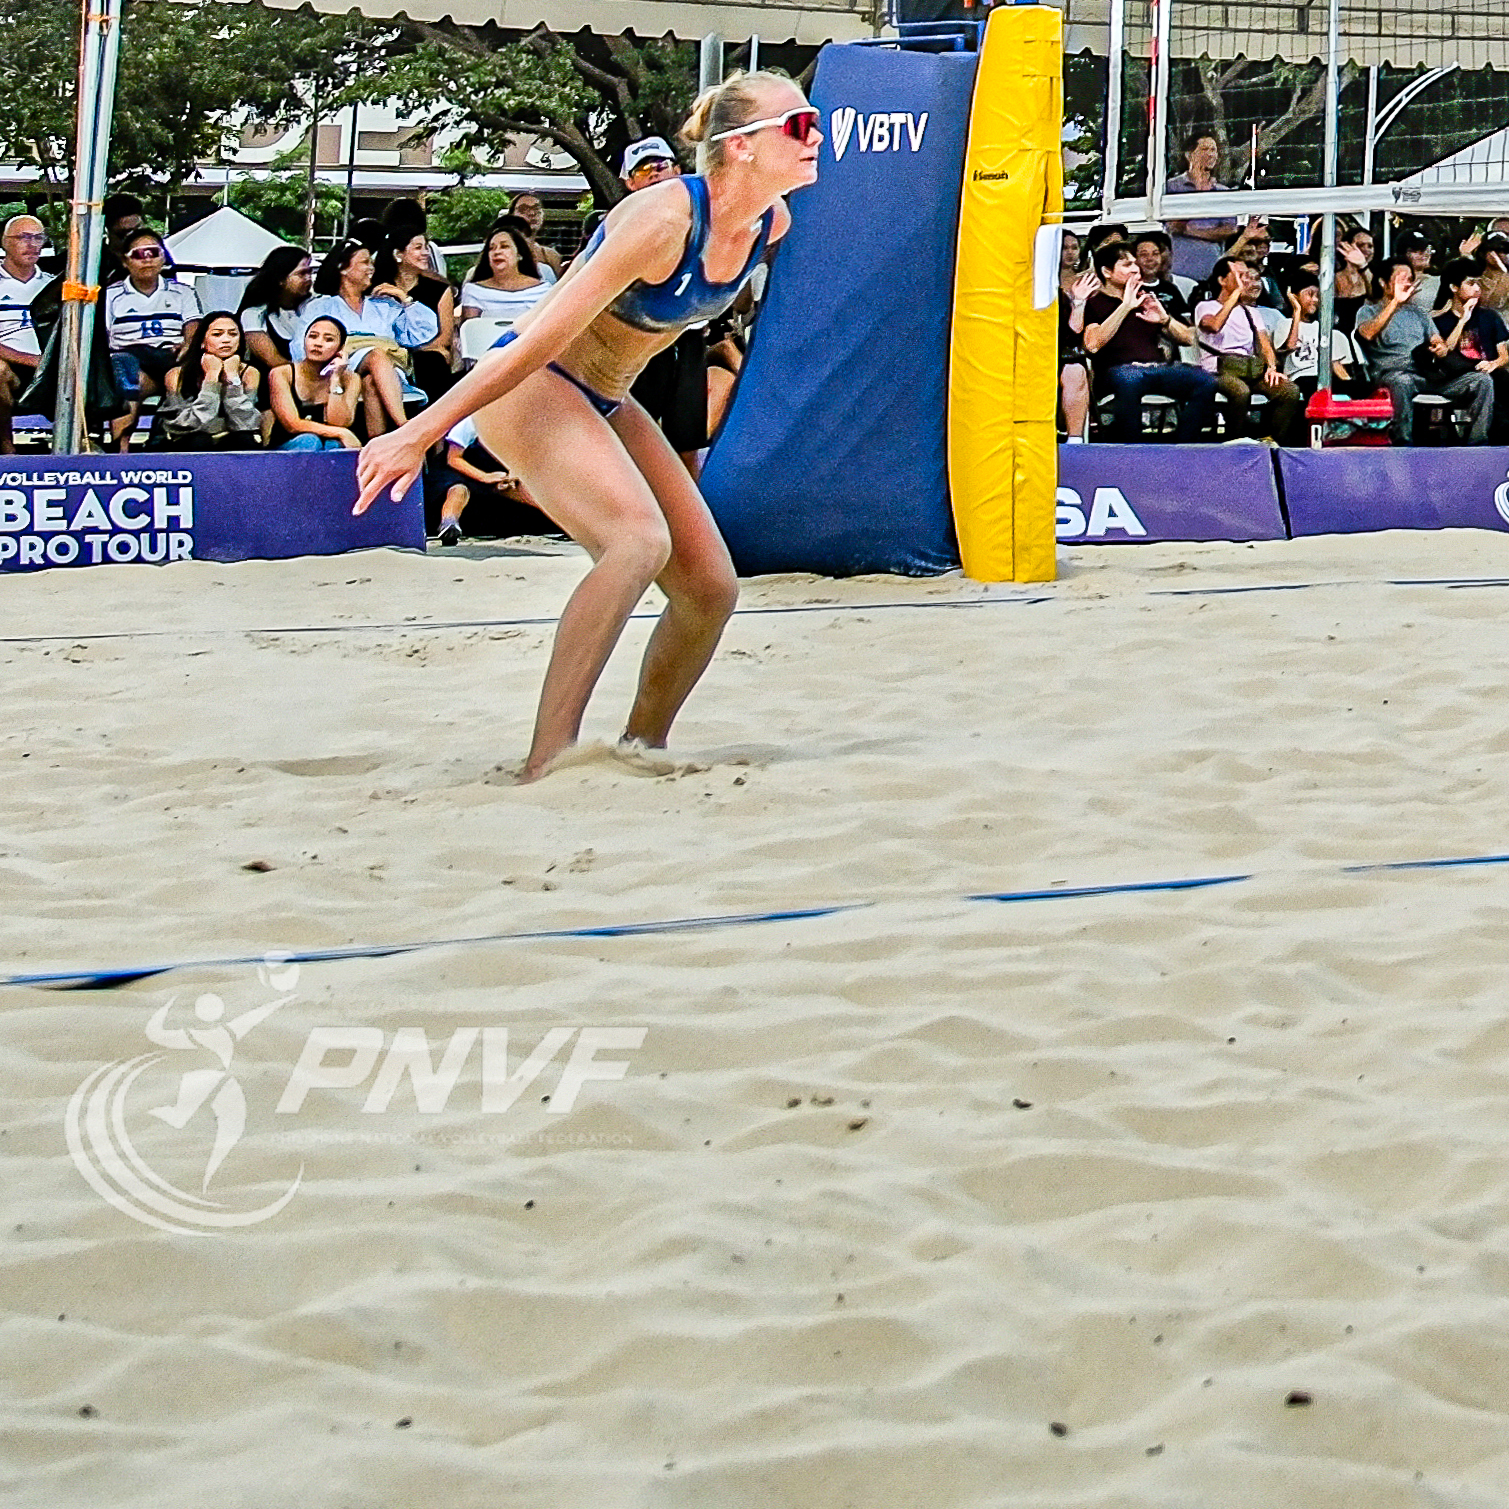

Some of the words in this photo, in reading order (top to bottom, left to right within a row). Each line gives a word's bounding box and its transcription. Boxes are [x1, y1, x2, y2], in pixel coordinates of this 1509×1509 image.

[857, 112, 929, 153] VBTV
[120, 470, 192, 485] WORLD
[0, 486, 193, 532] BEACH
[0, 533, 80, 565] PRO
[84, 532, 194, 564] TOUR
